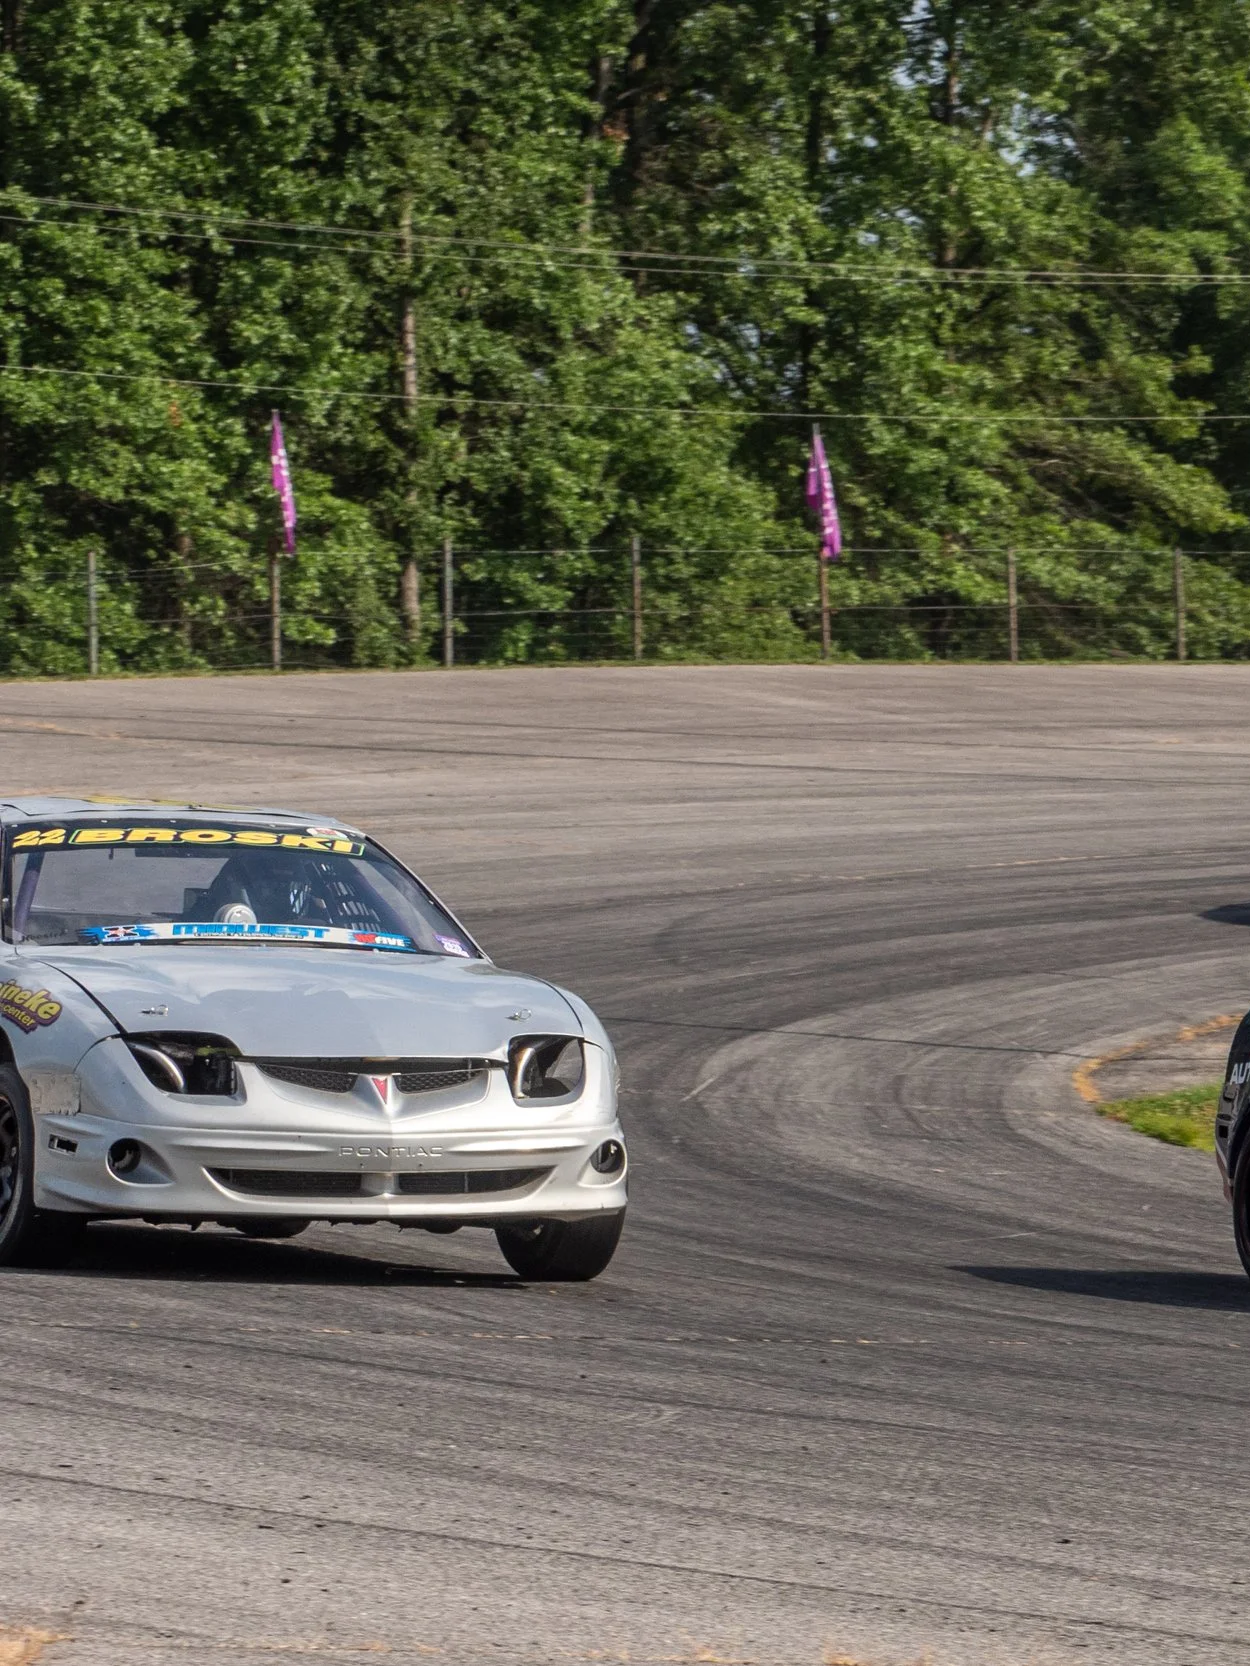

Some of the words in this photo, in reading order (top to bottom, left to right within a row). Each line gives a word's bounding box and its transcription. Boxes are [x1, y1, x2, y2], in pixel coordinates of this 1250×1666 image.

[12, 828, 66, 848] 22
[71, 828, 358, 856] BROSKI
[0, 979, 62, 1020] ineke
[338, 1145, 444, 1158] PONTIAC
